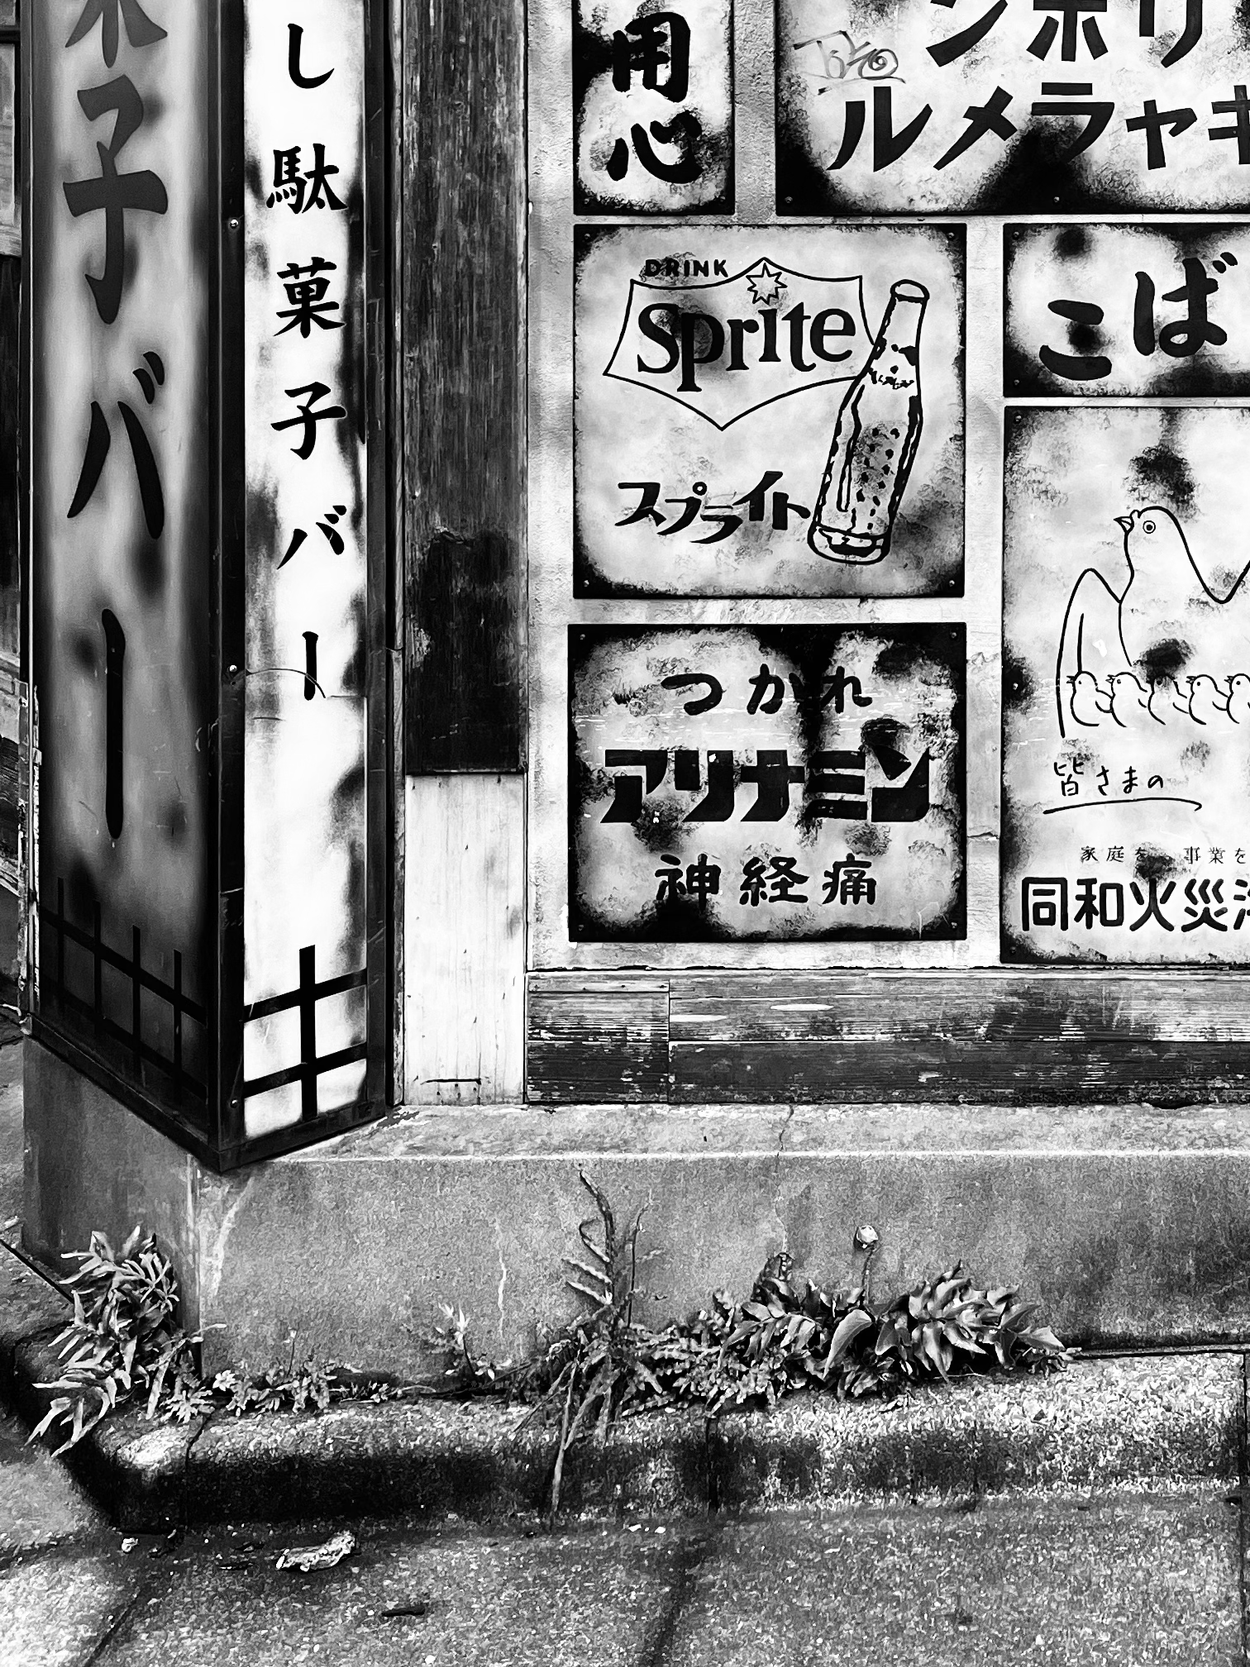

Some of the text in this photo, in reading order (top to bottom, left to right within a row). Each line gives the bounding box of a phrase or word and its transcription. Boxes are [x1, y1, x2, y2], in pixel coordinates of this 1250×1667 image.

[645, 258, 729, 278] DRINK
[637, 301, 857, 393] Sprite
[614, 470, 811, 545] スプライト
[661, 663, 873, 716] つかれ
[600, 746, 931, 823] アリナミン
[655, 853, 877, 906] 神経痛
